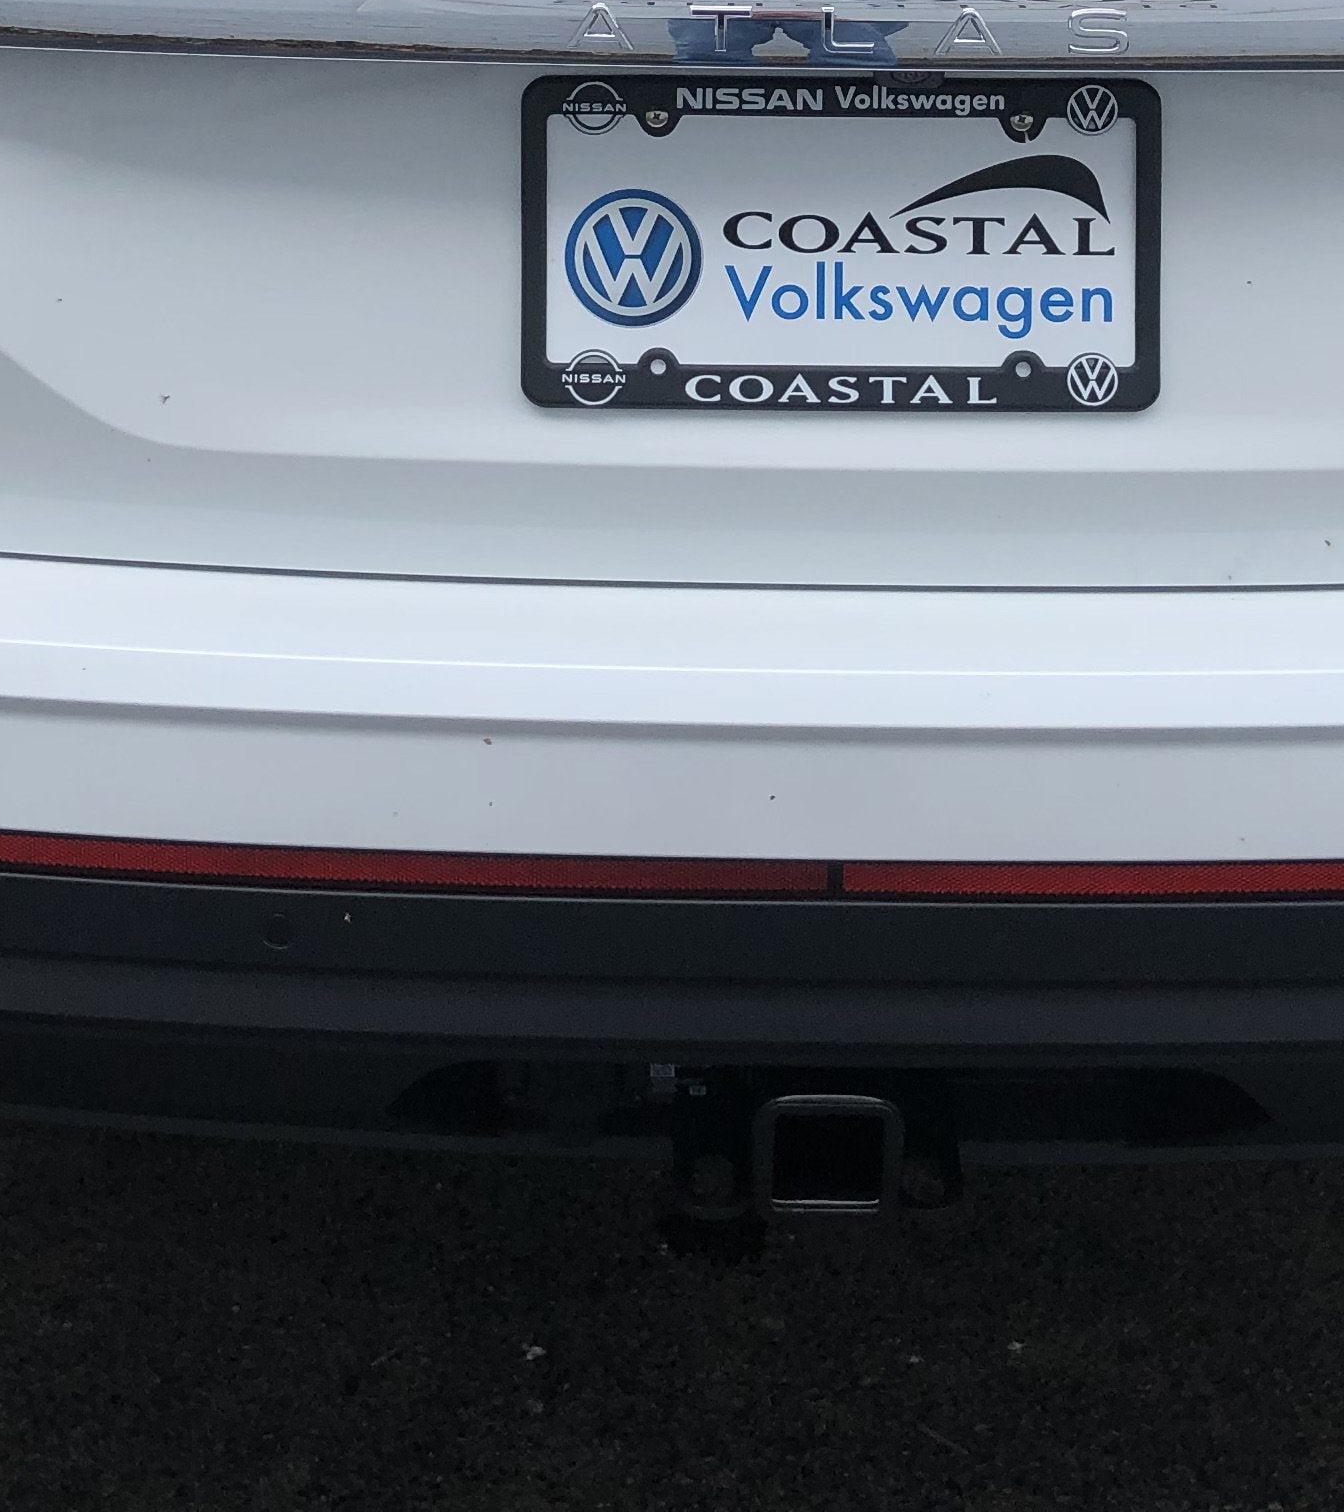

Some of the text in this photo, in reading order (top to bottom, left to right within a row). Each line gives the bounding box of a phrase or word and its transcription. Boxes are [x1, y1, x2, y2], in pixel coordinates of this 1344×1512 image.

[567, 2, 1130, 57] ATLAS
[562, 102, 627, 112] NISSAN
[676, 85, 1006, 115] NISSAN Volkswagen
[722, 210, 1116, 257] COASTAL
[724, 261, 1113, 339] Volkswagen
[561, 373, 626, 384] NISSAN
[684, 373, 998, 405] COASTAL
